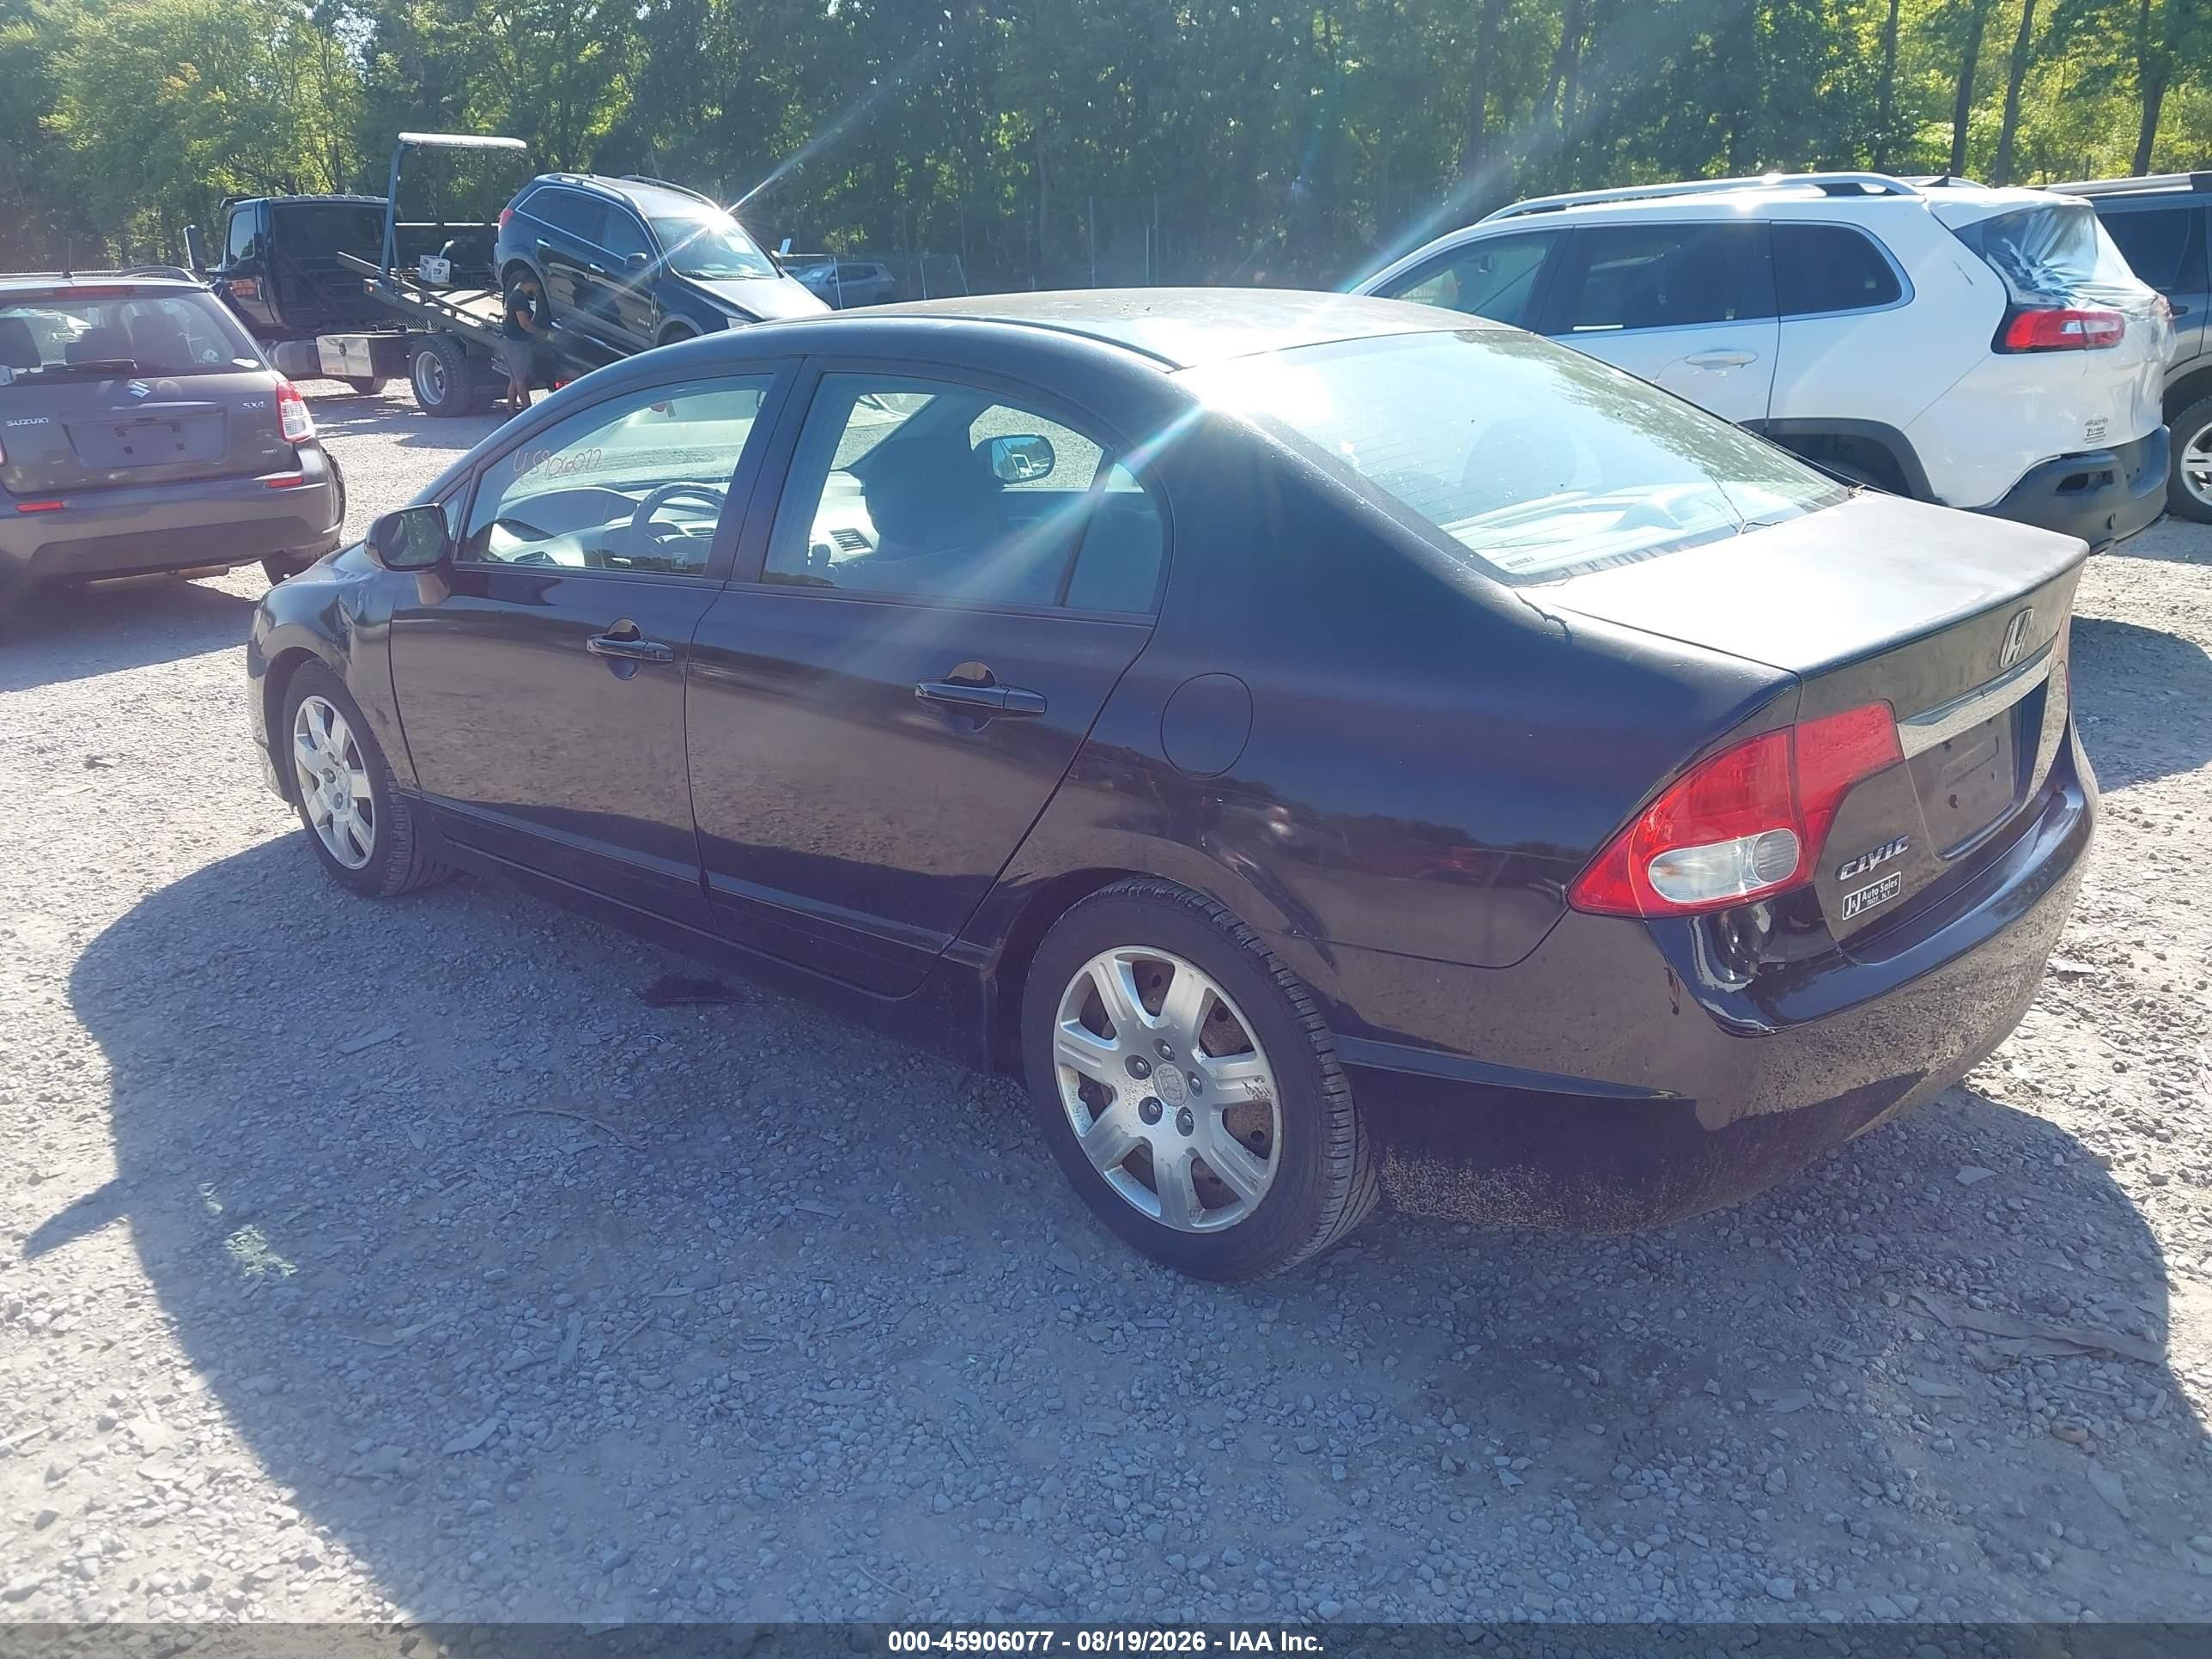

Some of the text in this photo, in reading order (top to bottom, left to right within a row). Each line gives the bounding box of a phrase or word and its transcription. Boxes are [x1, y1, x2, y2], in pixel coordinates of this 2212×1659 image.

[242, 400, 265, 409] SX4
[6, 417, 49, 427] SUZUKI
[1836, 835, 1910, 881] CIVIC
[1846, 878, 1899, 916] J&J Auto Sales
